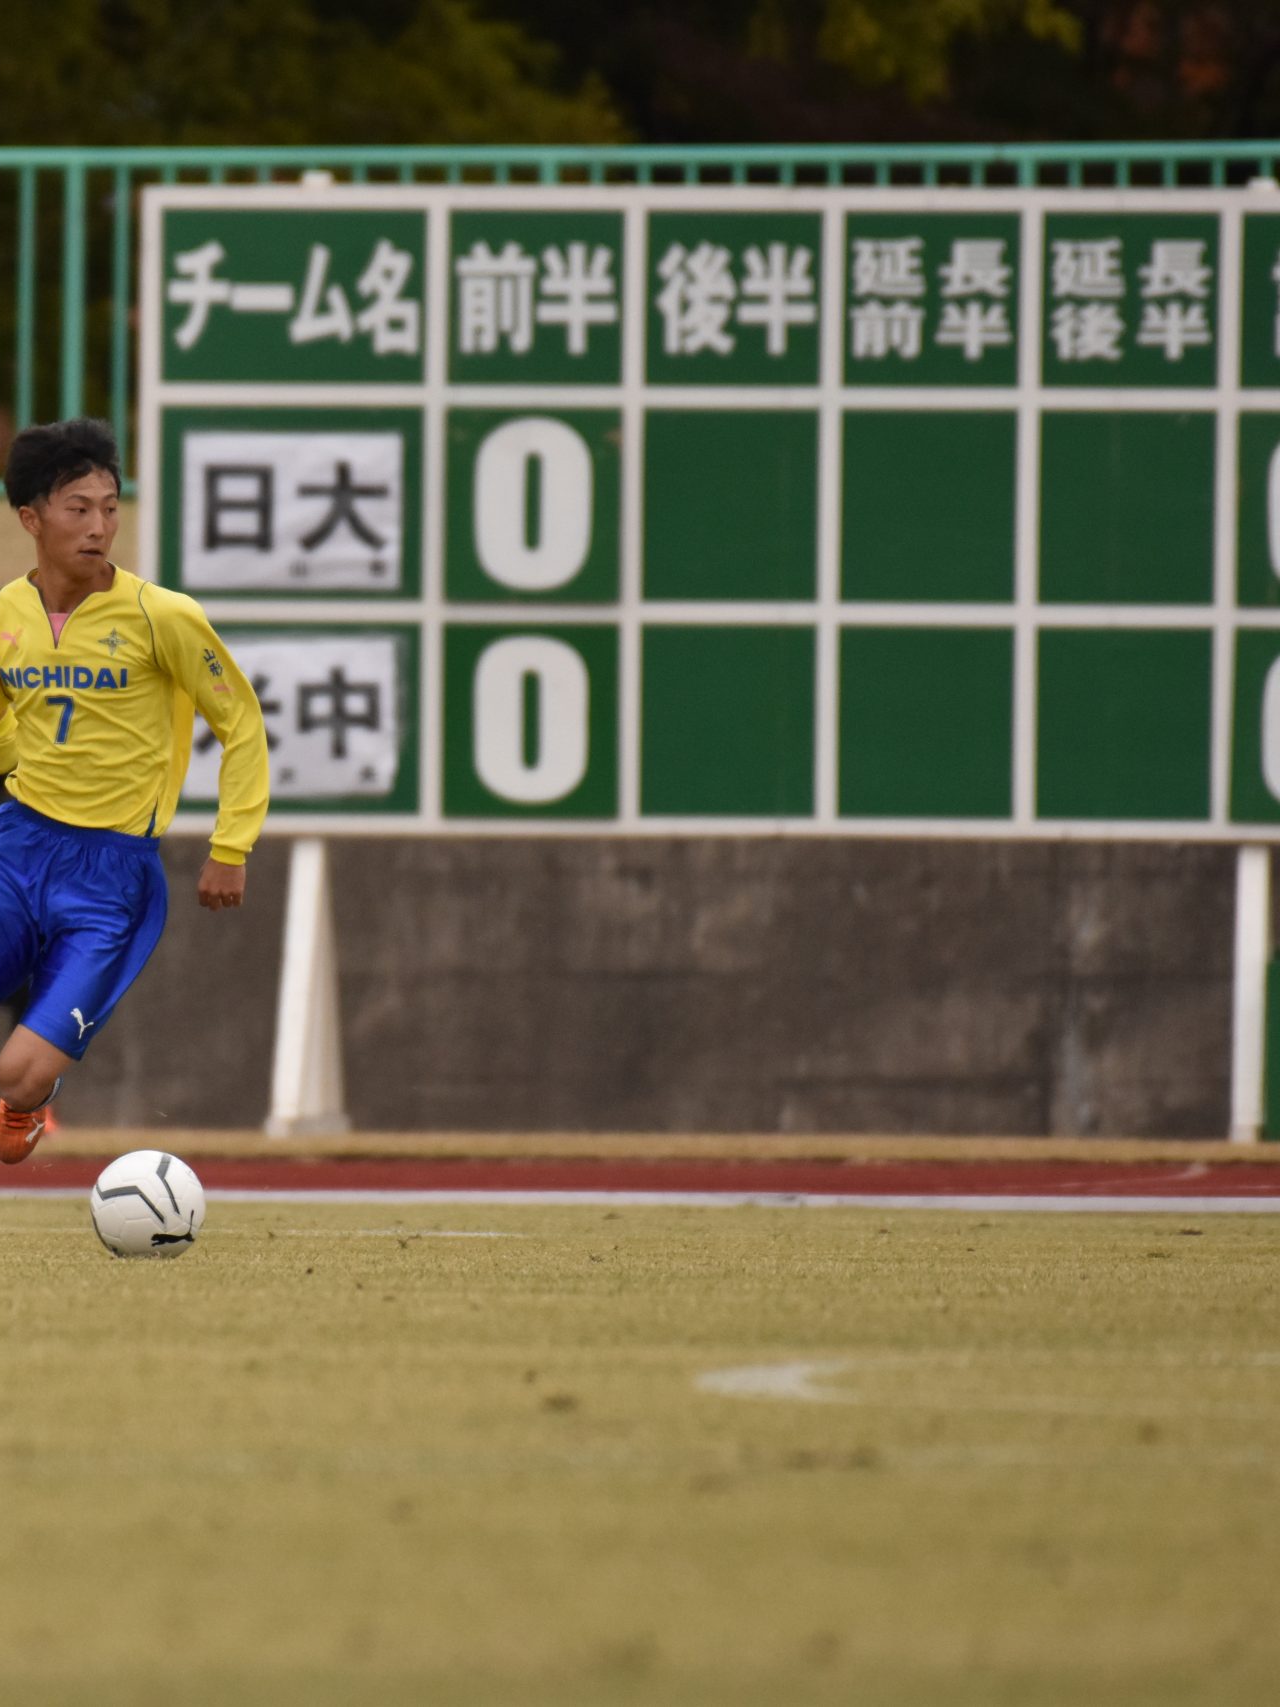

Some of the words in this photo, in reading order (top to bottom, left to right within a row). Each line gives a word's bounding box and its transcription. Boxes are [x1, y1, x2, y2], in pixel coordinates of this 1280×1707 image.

[167, 239, 420, 355] チーム名
[456, 240, 618, 355] 前半
[656, 242, 818, 356] 後半
[851, 237, 1012, 297] 延長
[1051, 238, 1212, 298] 延長
[850, 301, 1012, 359] 前半
[1051, 302, 1212, 361] 後半
[203, 460, 390, 553] 日大
[473, 416, 594, 591] 0
[0, 666, 128, 689] NICHIDAI
[44, 696, 75, 745] 7
[472, 635, 589, 804] 0
